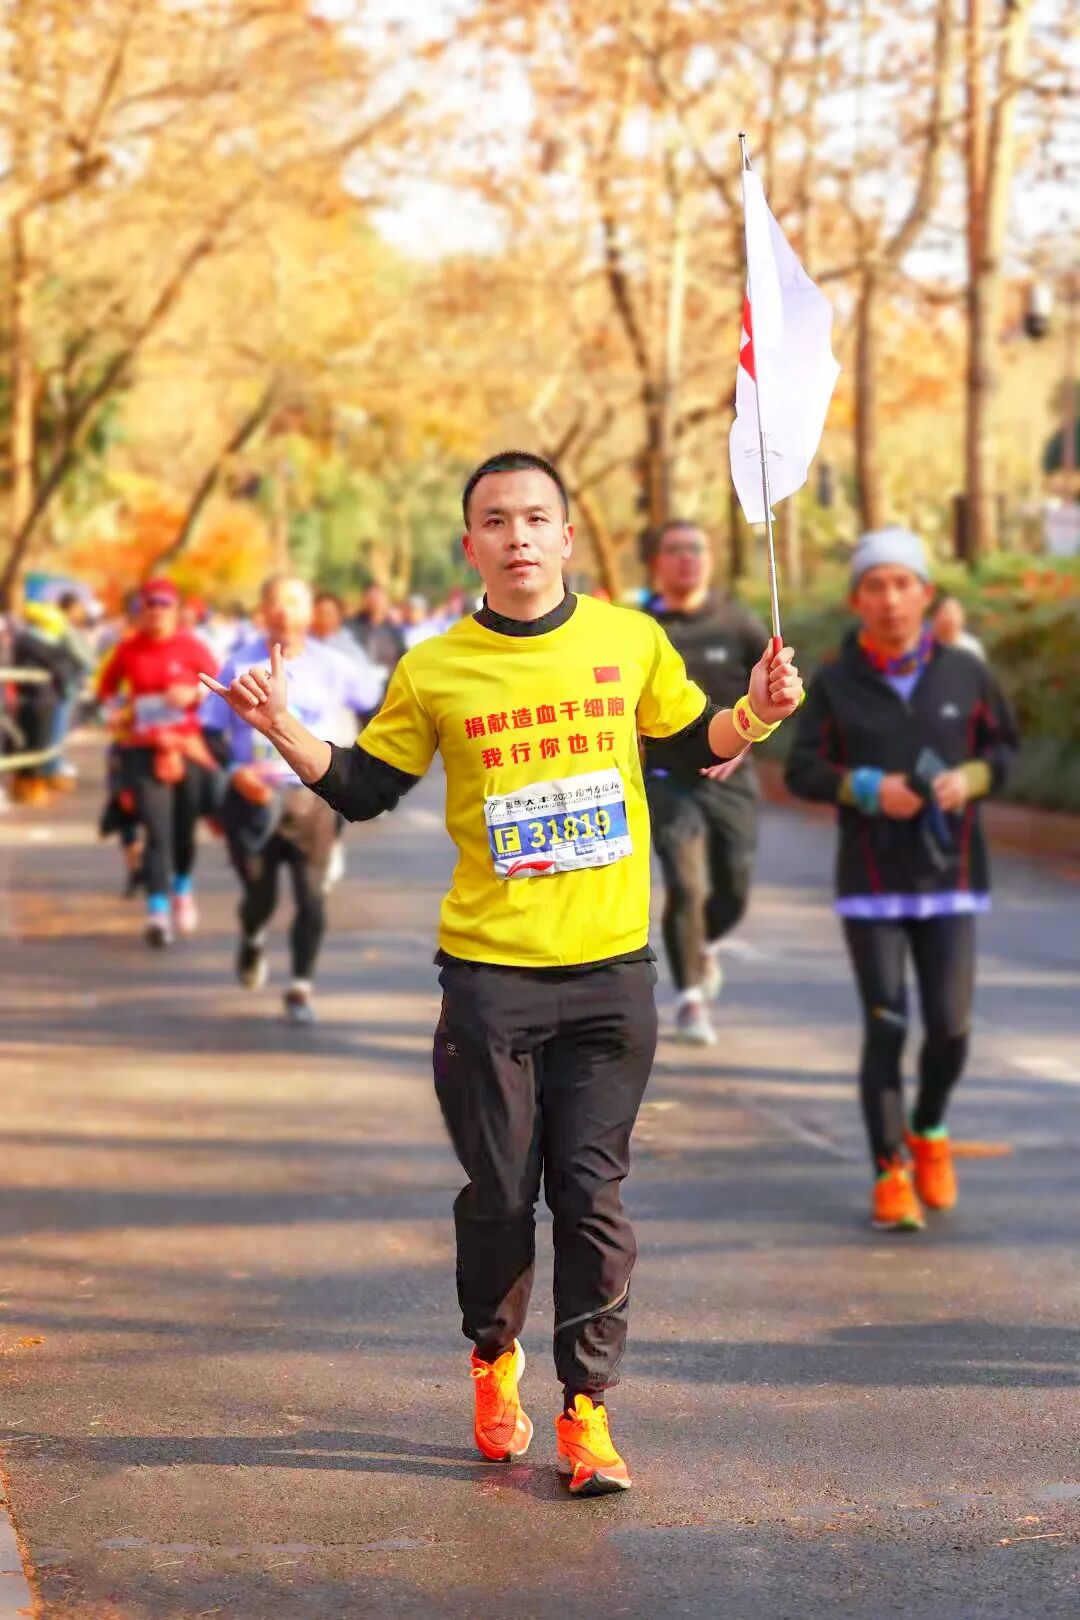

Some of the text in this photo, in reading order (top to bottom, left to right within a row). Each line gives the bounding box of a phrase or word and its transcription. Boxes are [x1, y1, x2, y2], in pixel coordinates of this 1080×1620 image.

[464, 697, 624, 739] 捐献造血干细胞
[481, 731, 615, 769] 我行你也行
[529, 809, 611, 848] 31819
